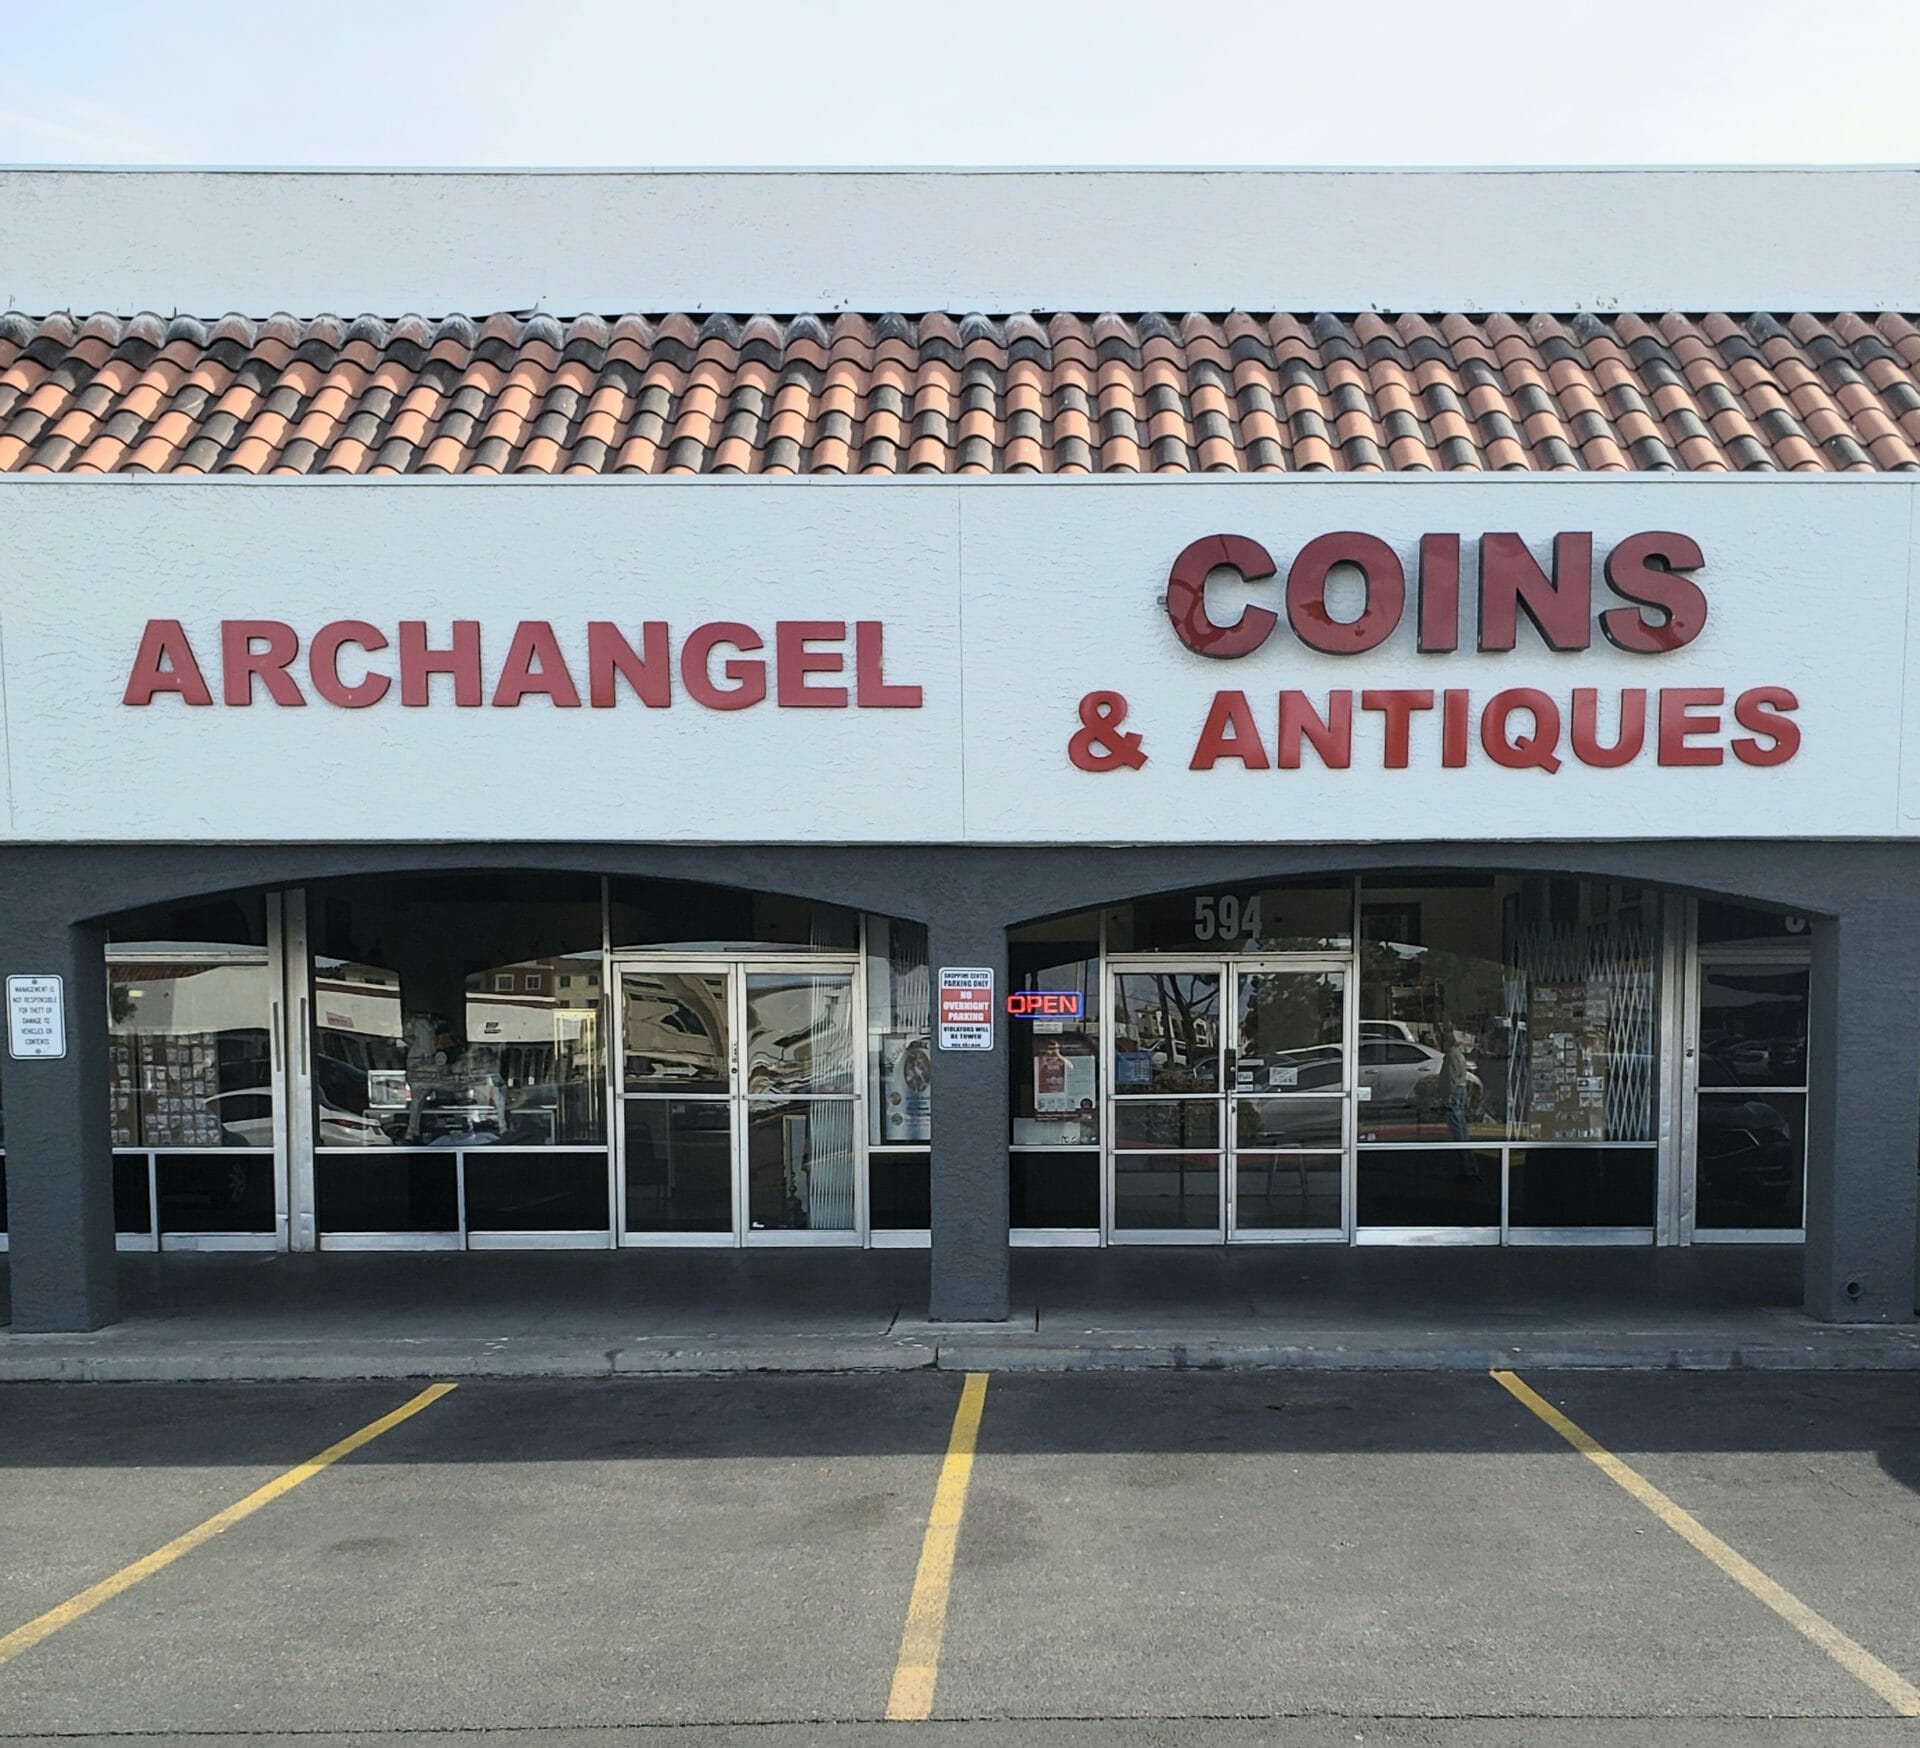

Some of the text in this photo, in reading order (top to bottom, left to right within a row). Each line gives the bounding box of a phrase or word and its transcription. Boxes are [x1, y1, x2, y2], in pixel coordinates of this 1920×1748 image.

[1166, 531, 1706, 657] COINS
[124, 619, 923, 711] ARCHANGEL
[1067, 686, 1801, 774] & ANTIQUES
[1194, 895, 1262, 940] 594
[943, 1001, 990, 1010] OVERNIGHT
[960, 991, 973, 1000] NO
[1007, 994, 1079, 1015] OPEN
[948, 1012, 984, 1021] PARKING
